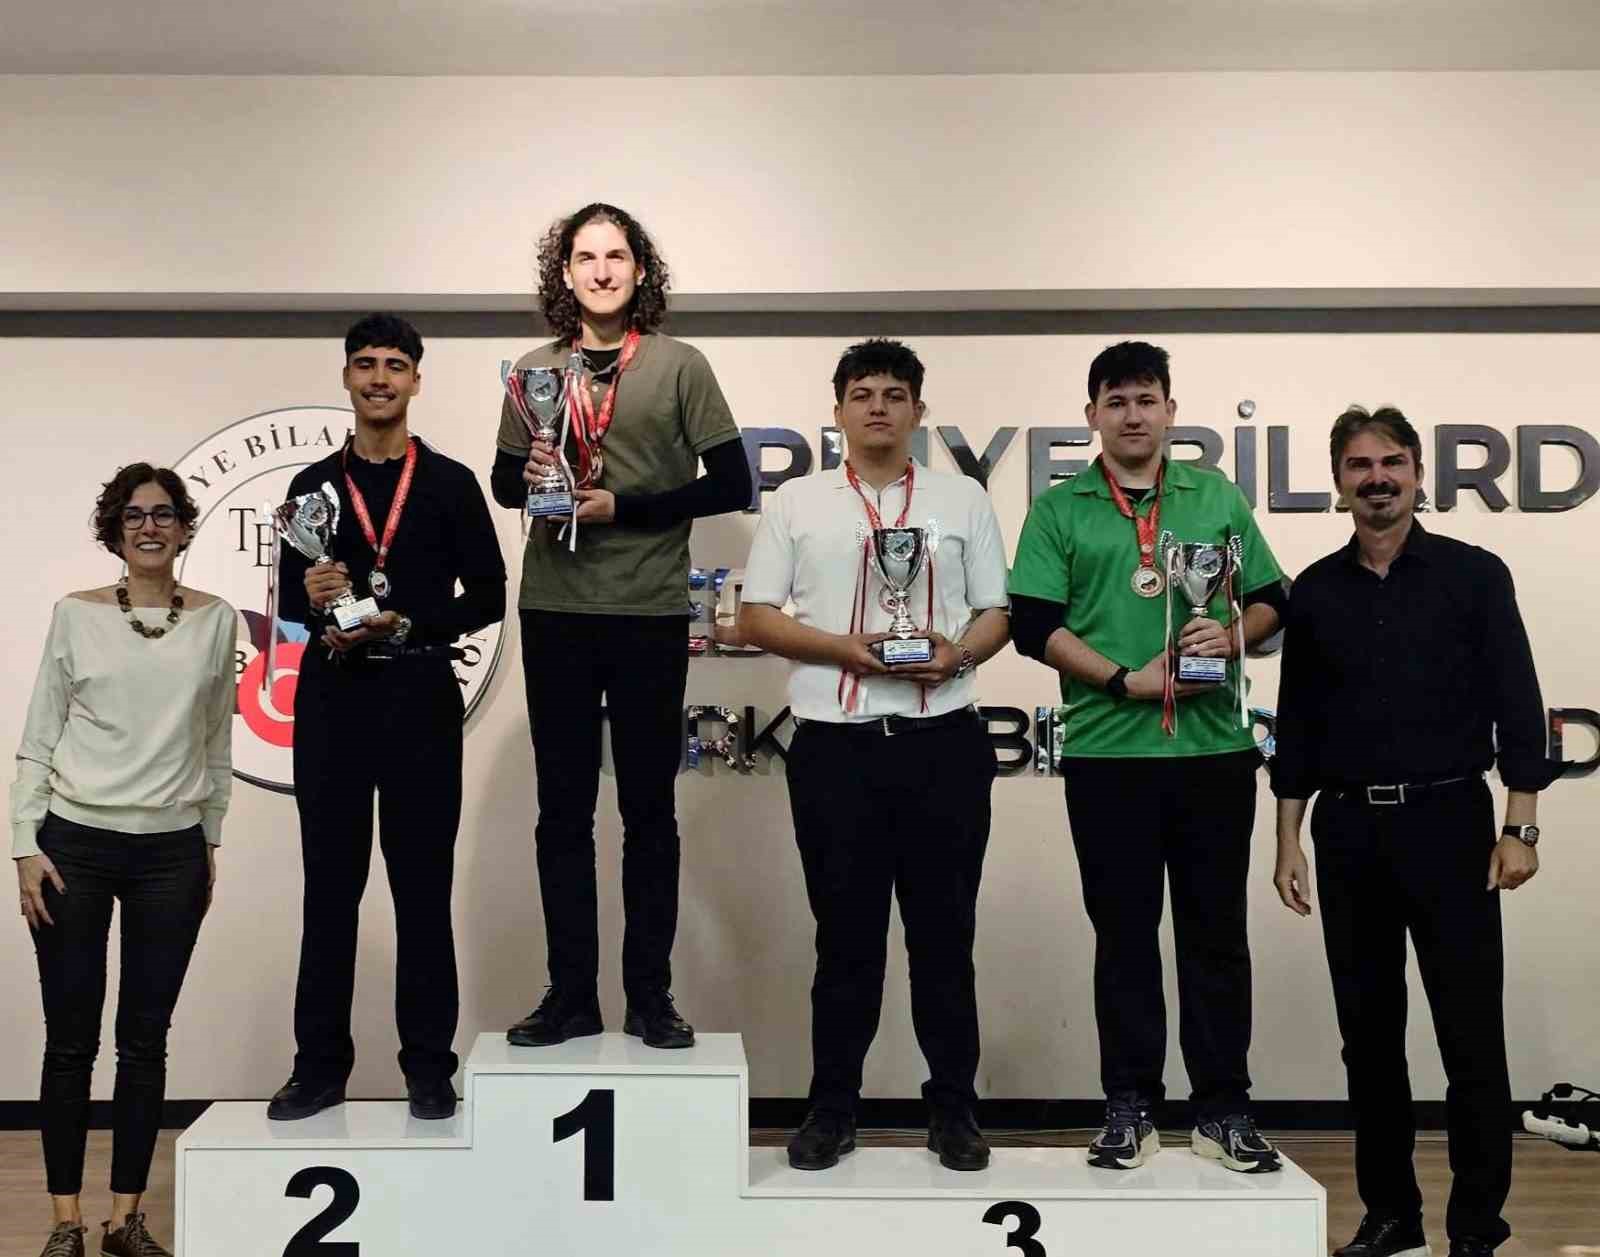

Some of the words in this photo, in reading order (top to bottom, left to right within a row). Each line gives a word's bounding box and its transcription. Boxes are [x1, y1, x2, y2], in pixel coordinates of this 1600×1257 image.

[553, 1089, 615, 1201] 1
[283, 1166, 360, 1257] 2
[982, 1201, 1047, 1257] 3
